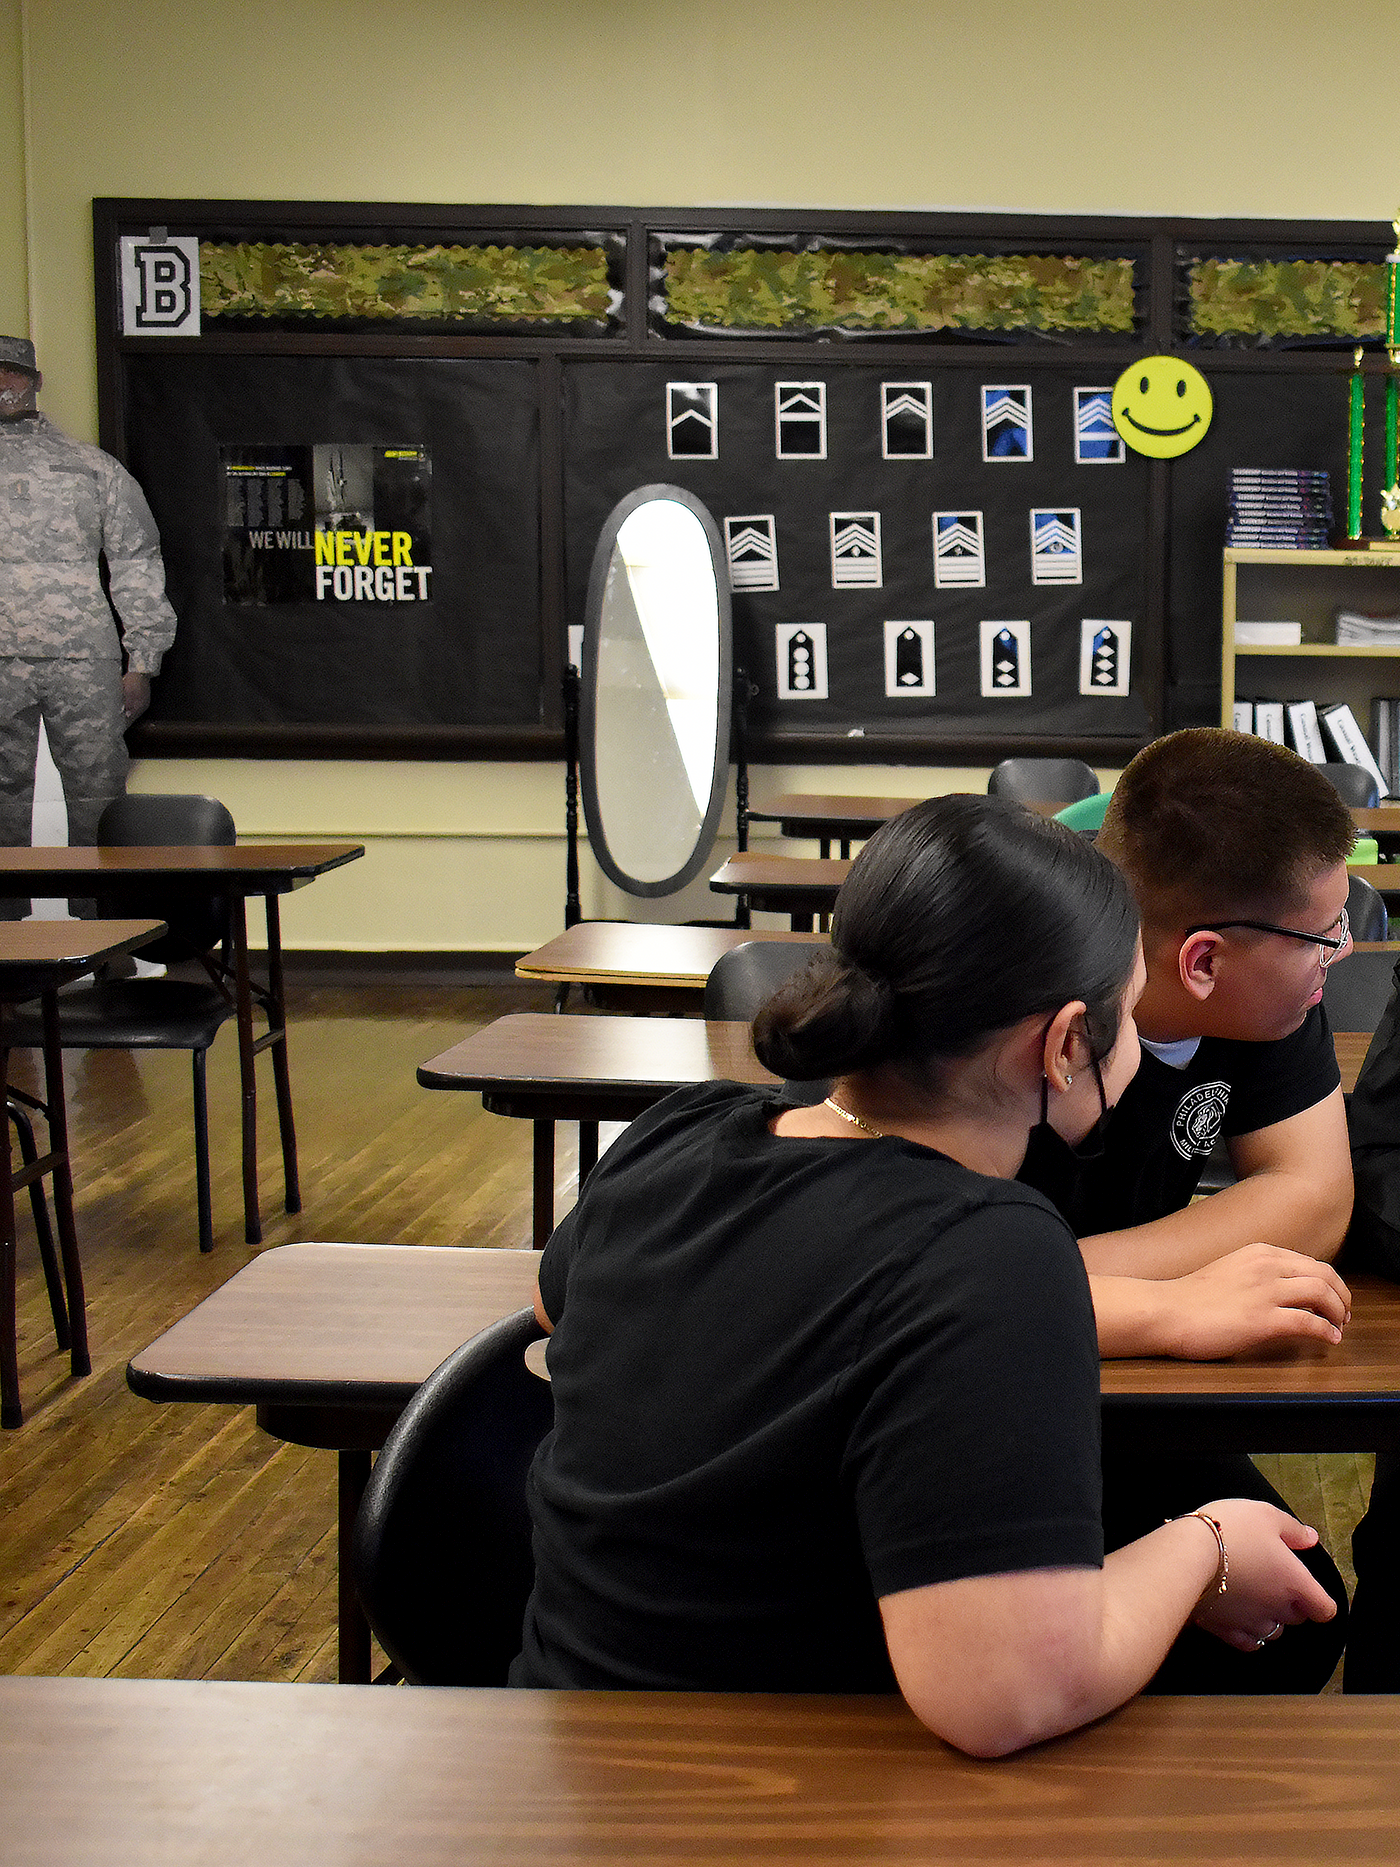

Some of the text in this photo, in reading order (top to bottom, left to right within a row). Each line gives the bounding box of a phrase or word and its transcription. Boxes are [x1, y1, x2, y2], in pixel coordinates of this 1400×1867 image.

[134, 245, 192, 328] B
[249, 530, 413, 567] WE WILL NEVER
[316, 566, 433, 601] FORGET
